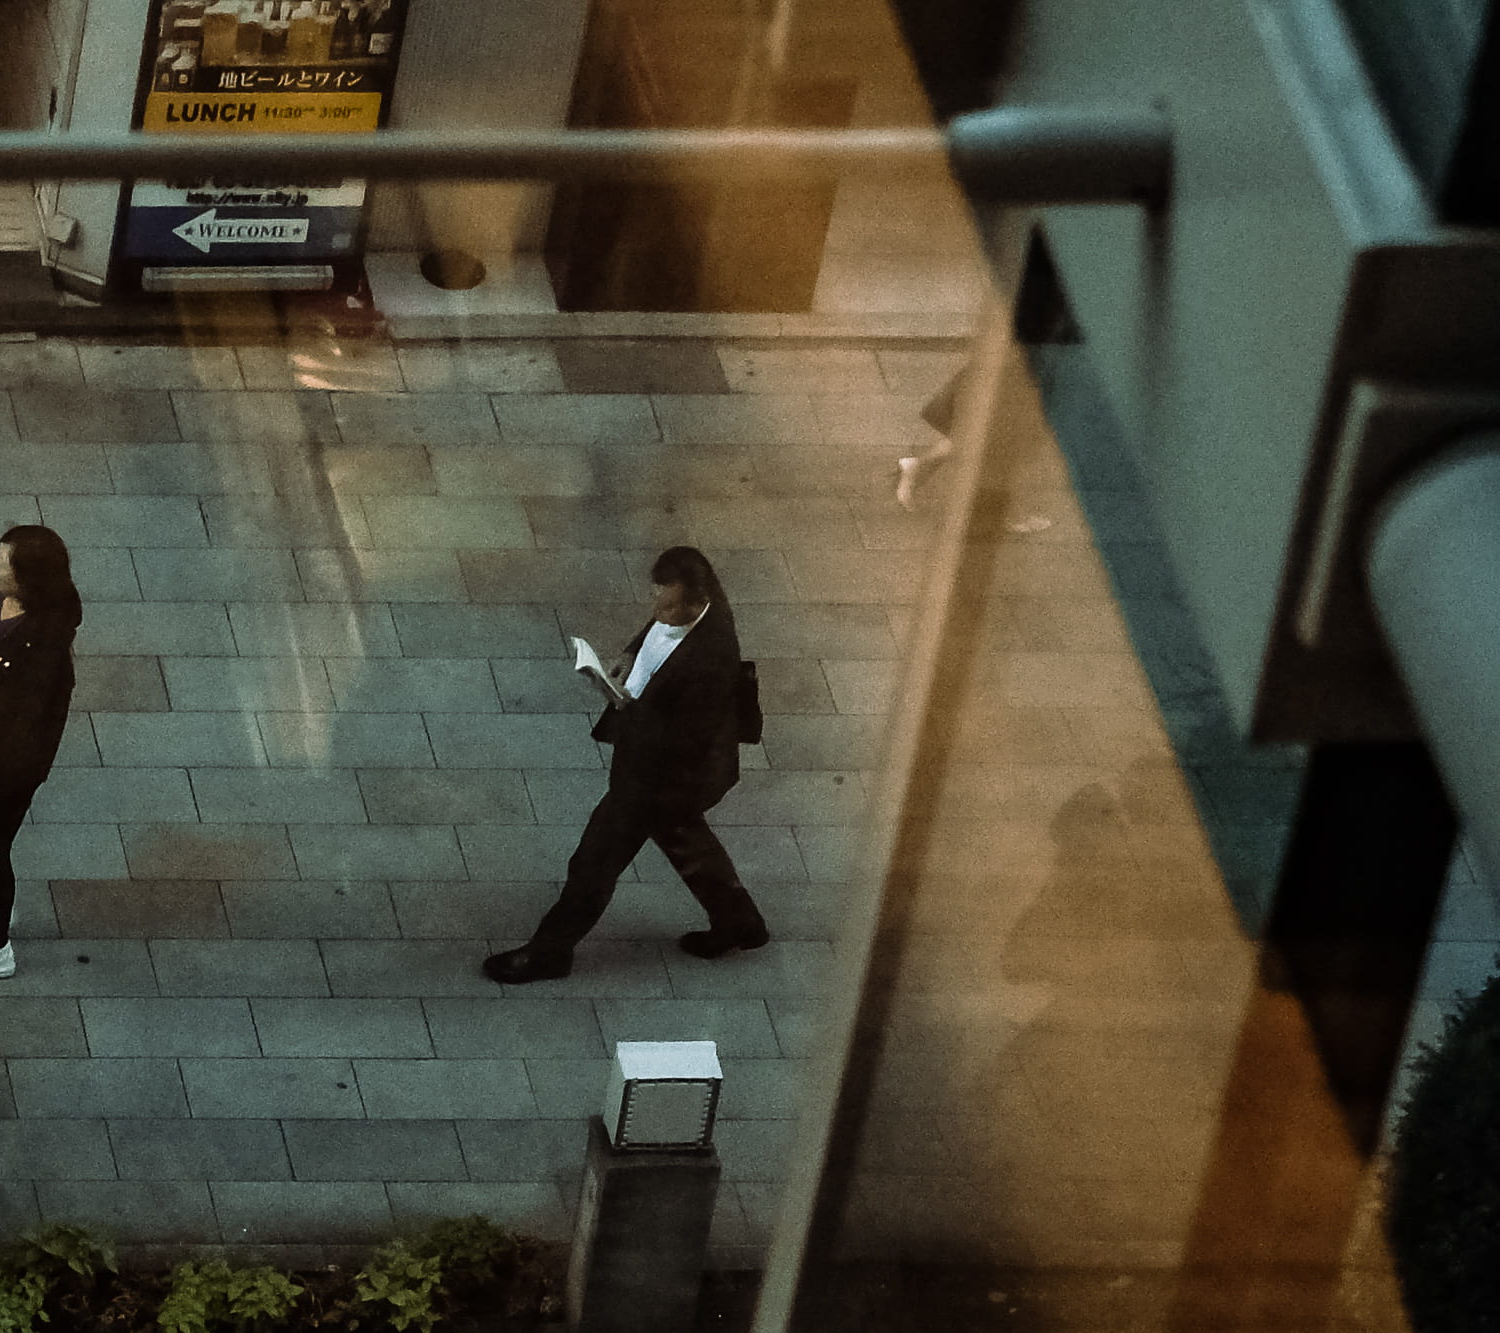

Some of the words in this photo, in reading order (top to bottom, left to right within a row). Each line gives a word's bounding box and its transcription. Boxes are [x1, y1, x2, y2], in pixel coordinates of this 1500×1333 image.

[218, 71, 364, 89] 地ビールとワイン
[167, 103, 257, 122] LUNCH
